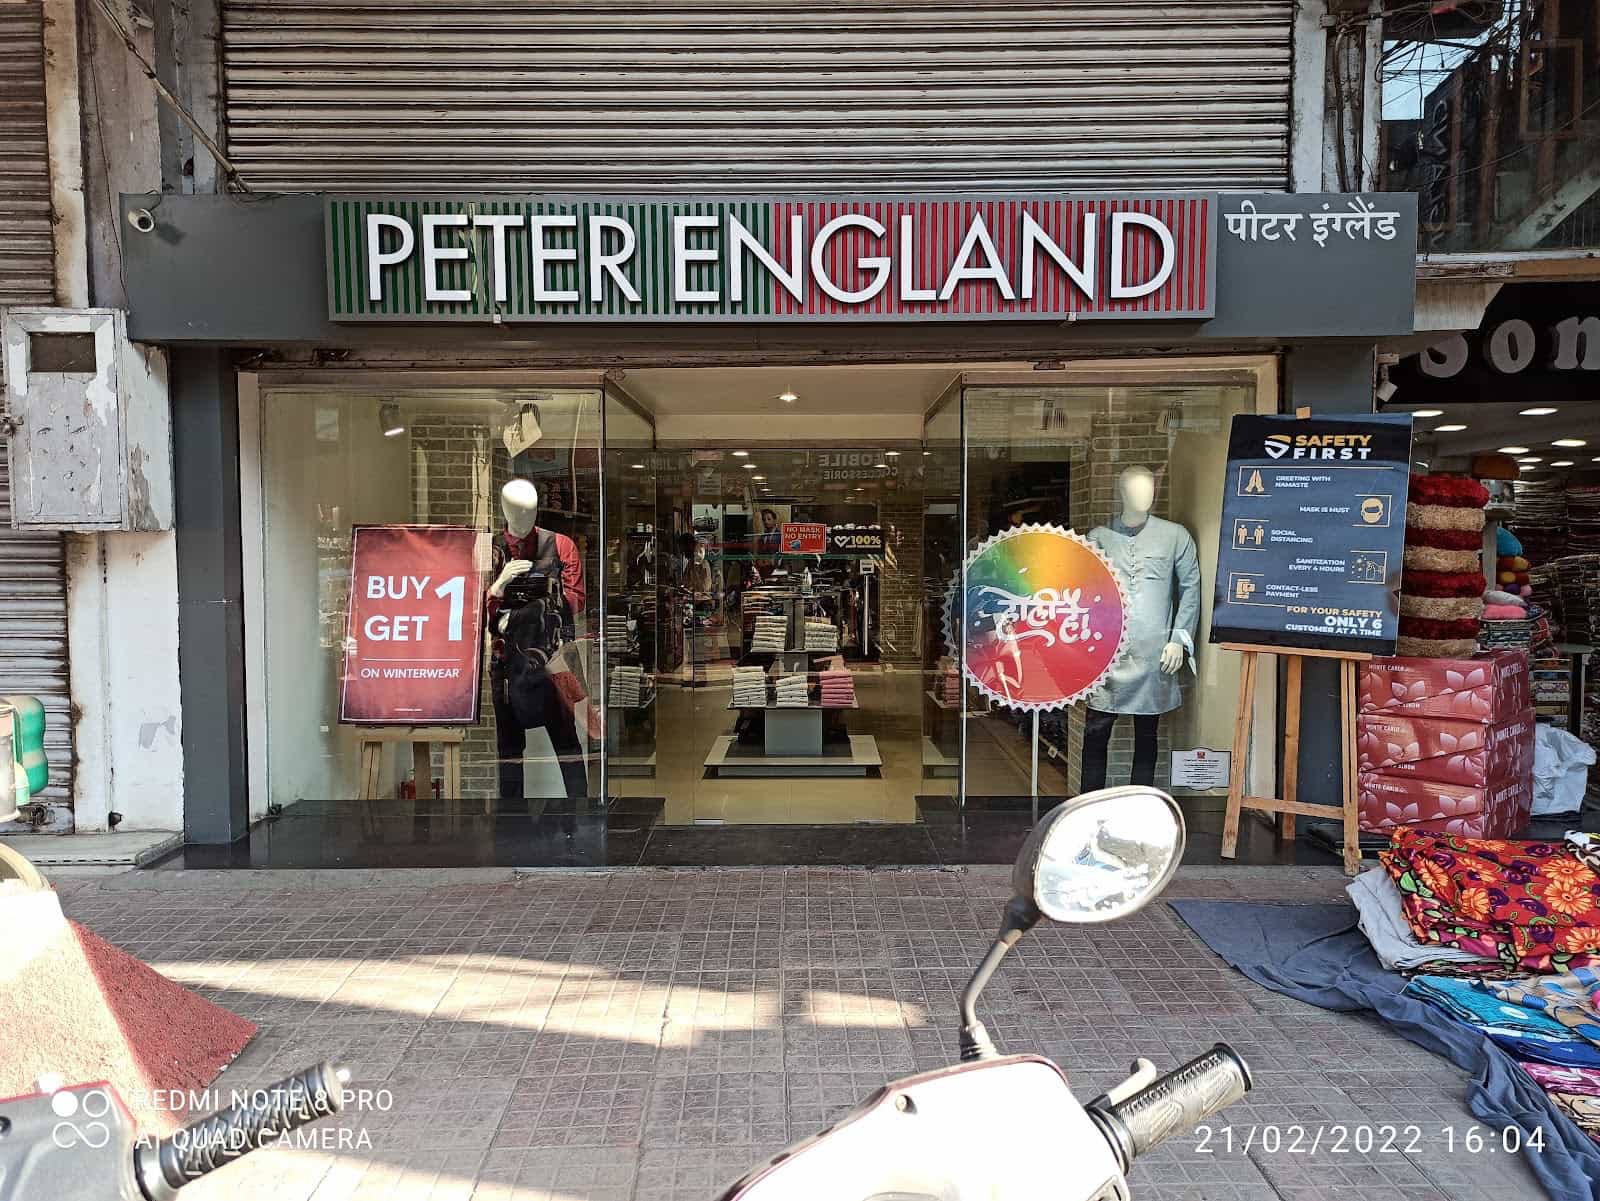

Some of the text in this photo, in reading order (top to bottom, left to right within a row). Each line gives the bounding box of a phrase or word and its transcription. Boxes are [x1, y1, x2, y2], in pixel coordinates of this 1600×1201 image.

[1224, 196, 1400, 248] पीटर इंग्लैंड
[367, 211, 1175, 304] PETER ENGLAND
[1295, 434, 1373, 447] SAFETY
[1293, 447, 1372, 460] FIRST
[850, 535, 881, 545] 100%
[1296, 558, 1345, 566] SANITIZATION
[1319, 565, 1345, 573] HOURS
[367, 575, 432, 600] BUY
[1265, 584, 1319, 593] CONTACT-LESS
[434, 576, 466, 641] 1
[1286, 605, 1382, 618] FOR YOUR SAFETY
[364, 615, 430, 641] GET
[1324, 615, 1383, 629] ONLY 6
[1285, 623, 1382, 637] CUSTOMER AT A TIME
[360, 668, 380, 679] ON
